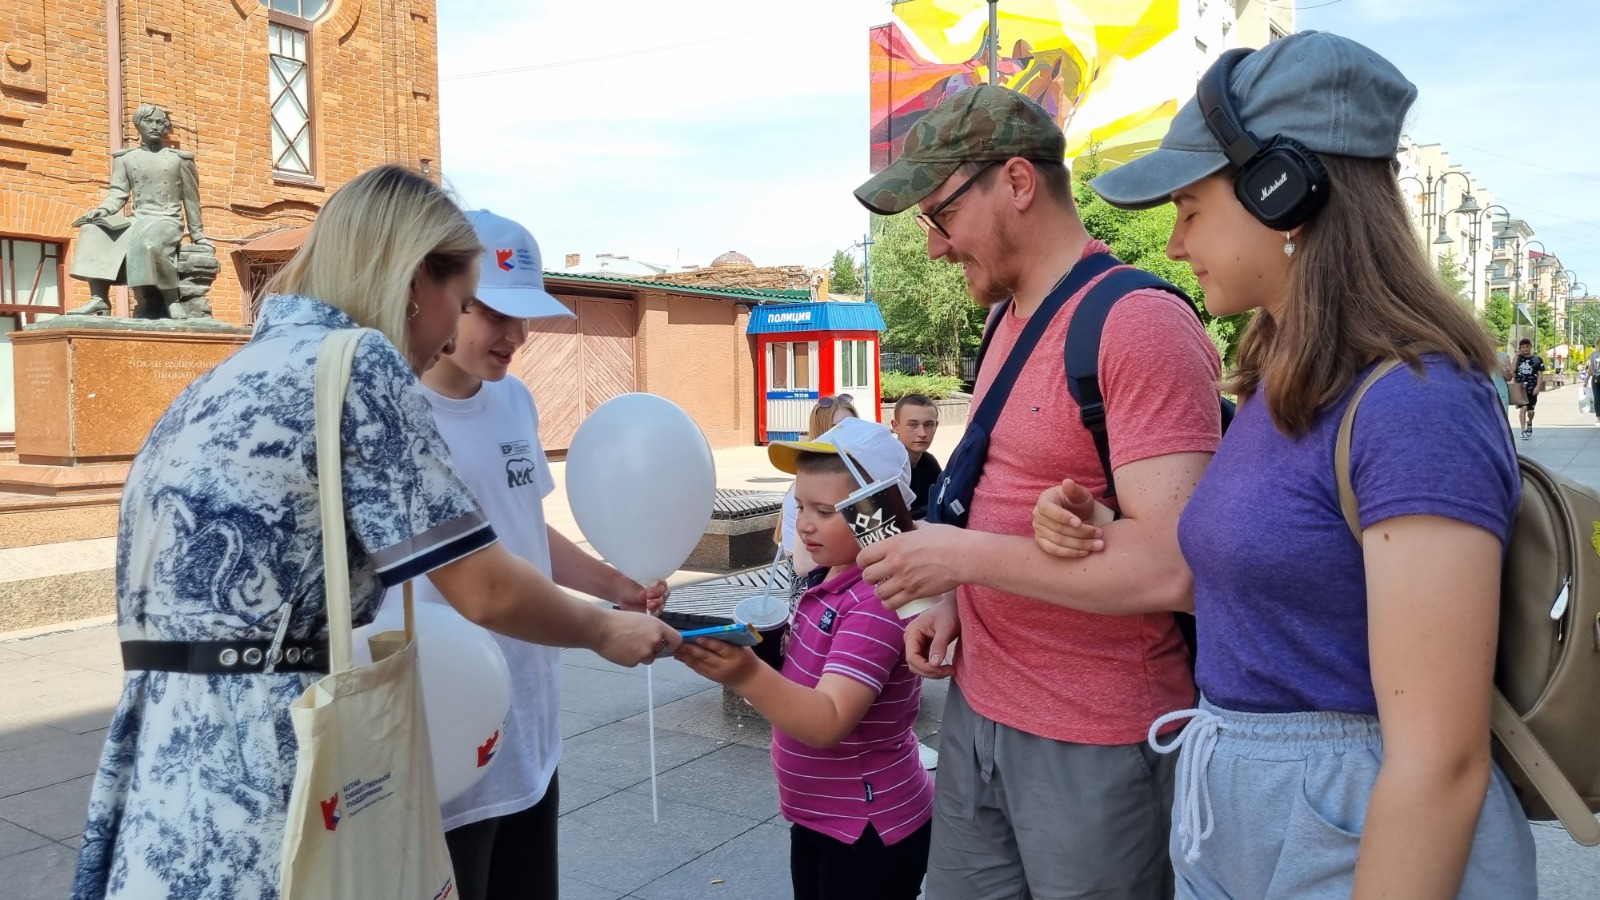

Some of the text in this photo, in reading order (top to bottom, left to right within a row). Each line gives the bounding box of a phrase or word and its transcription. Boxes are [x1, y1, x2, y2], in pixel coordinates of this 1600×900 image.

[1260, 171, 1288, 201] Marshall
[767, 311, 811, 324] ПОЛИЦИЯ
[344, 779, 361, 792] ШТАБ
